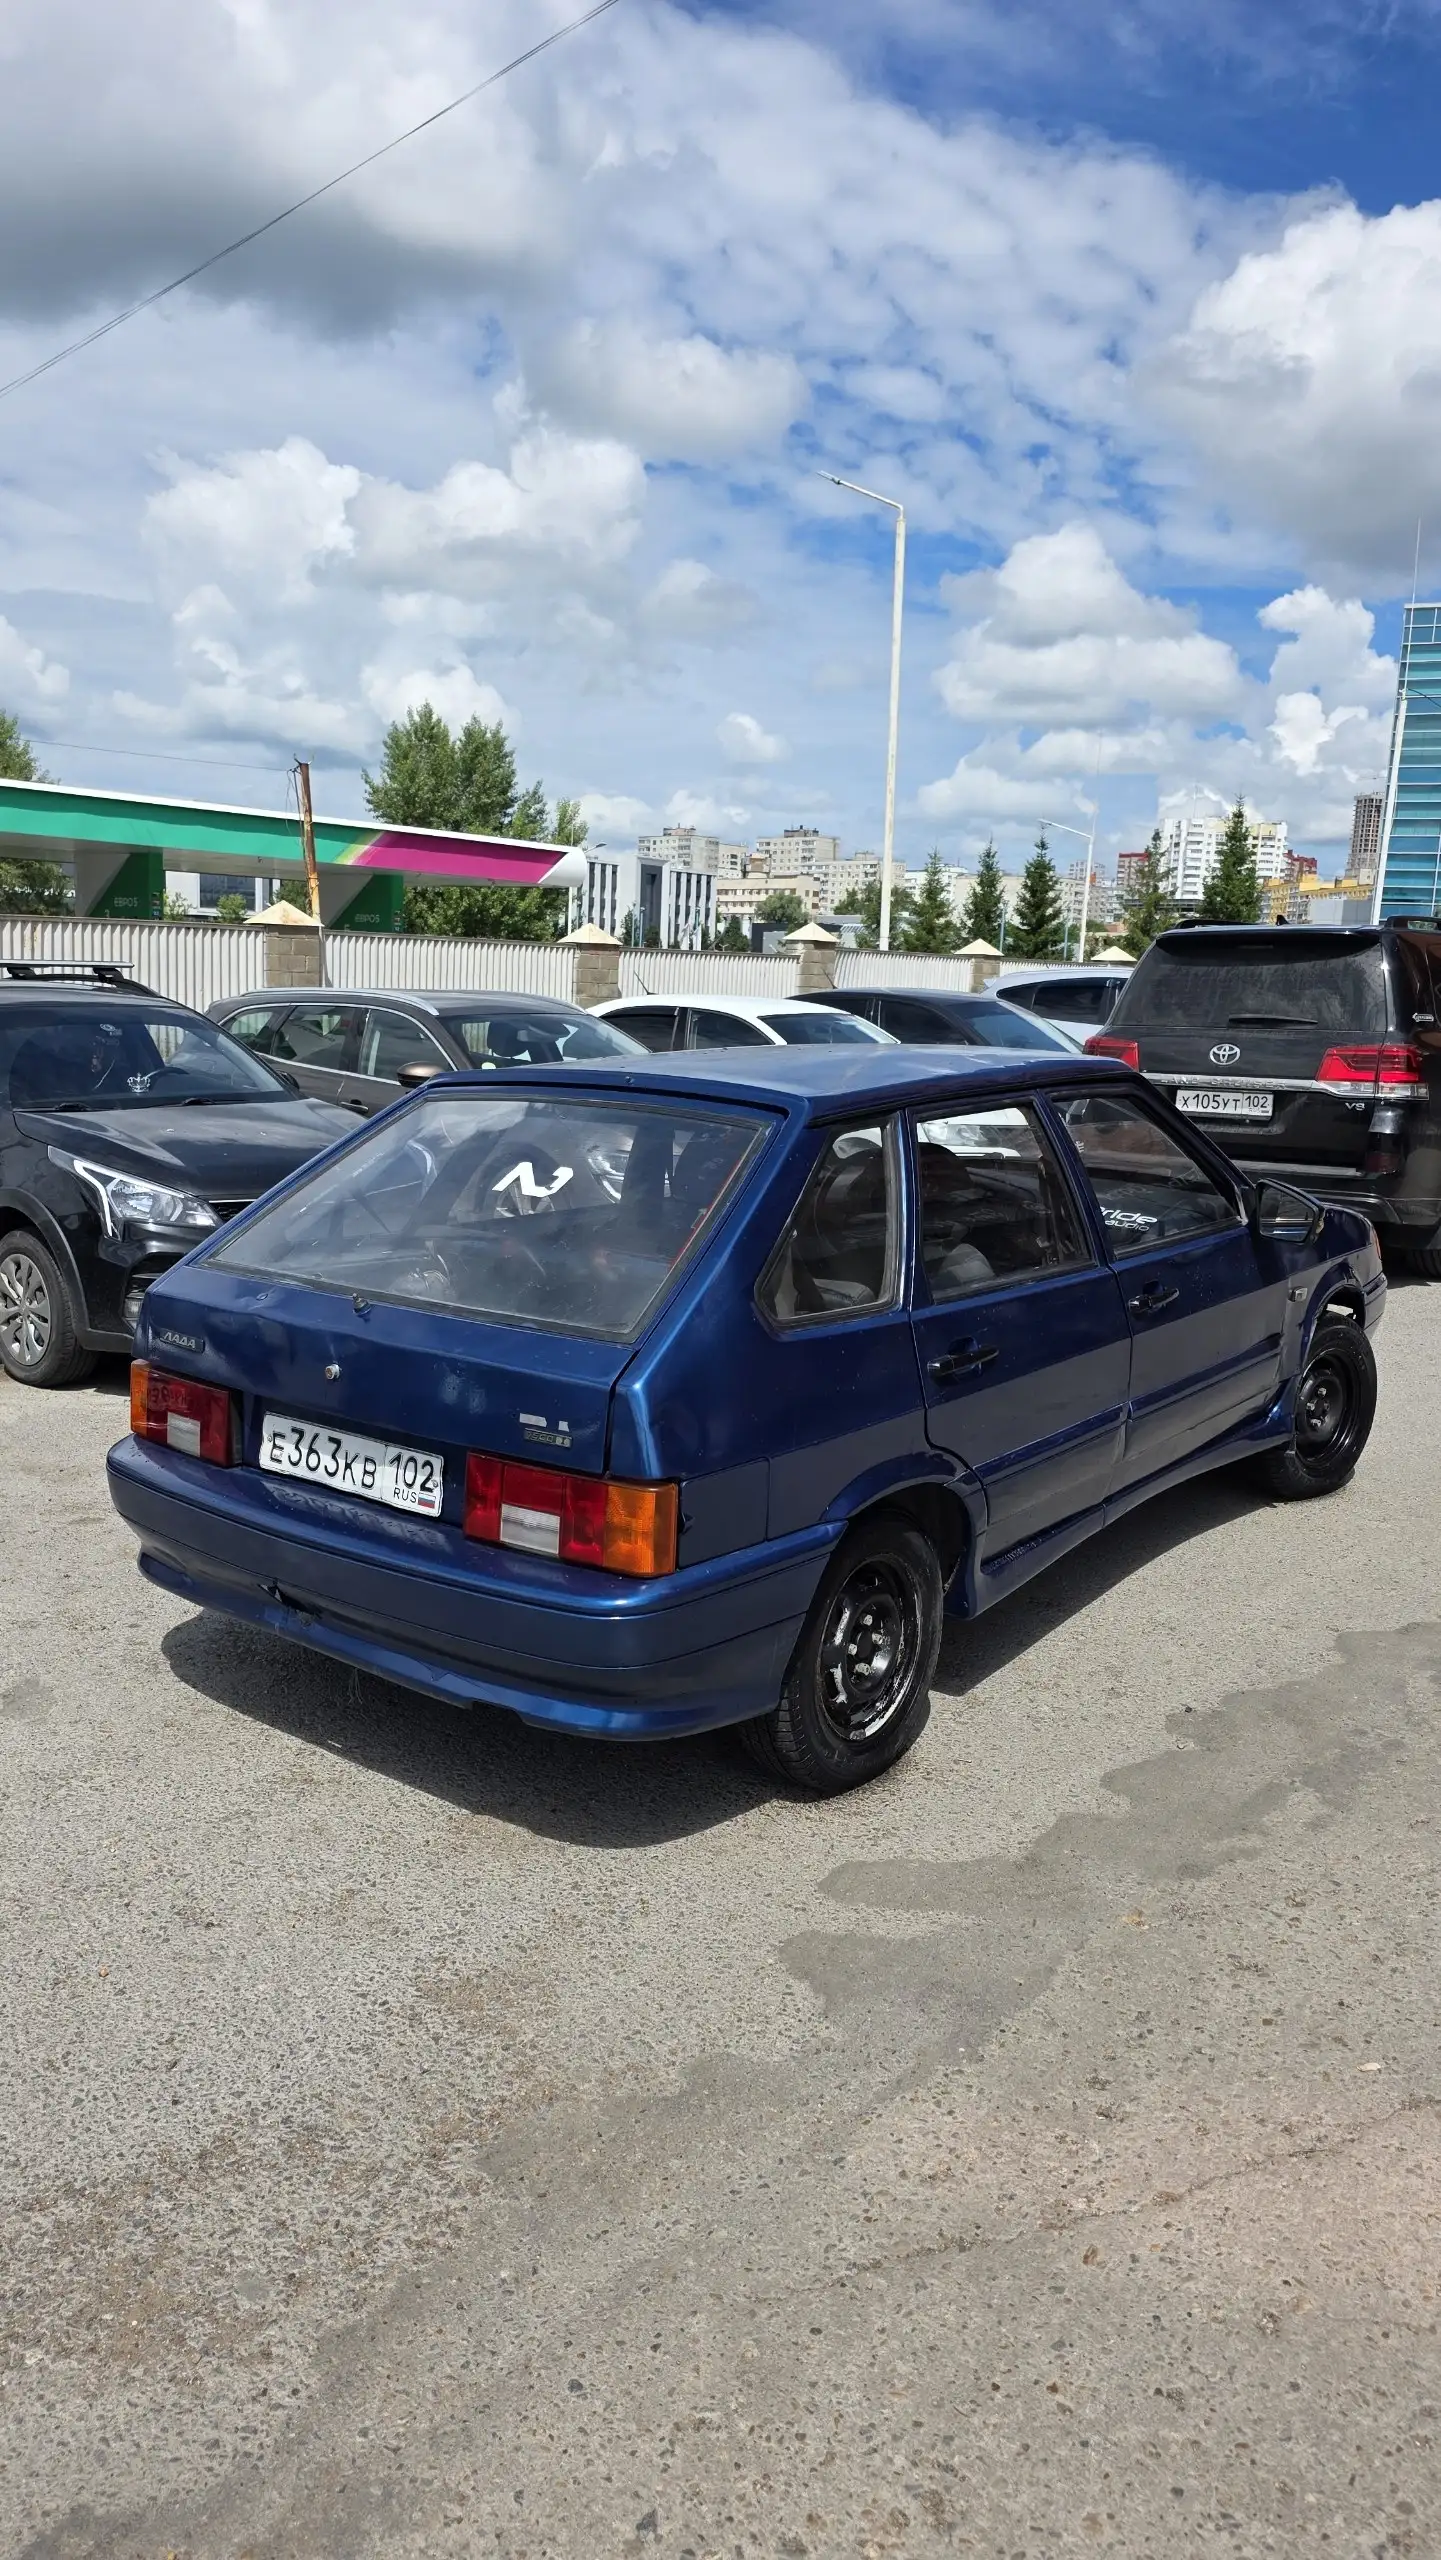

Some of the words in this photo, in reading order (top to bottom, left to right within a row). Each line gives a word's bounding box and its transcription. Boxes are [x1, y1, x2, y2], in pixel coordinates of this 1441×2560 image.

[1161, 1076, 1200, 1084] LAND
[1211, 1078, 1286, 1090] CRUISER
[1245, 1095, 1268, 1109] 102
[1104, 1219, 1150, 1232] audio
[389, 1451, 434, 1493] 102
[393, 1487, 417, 1504] RUS
